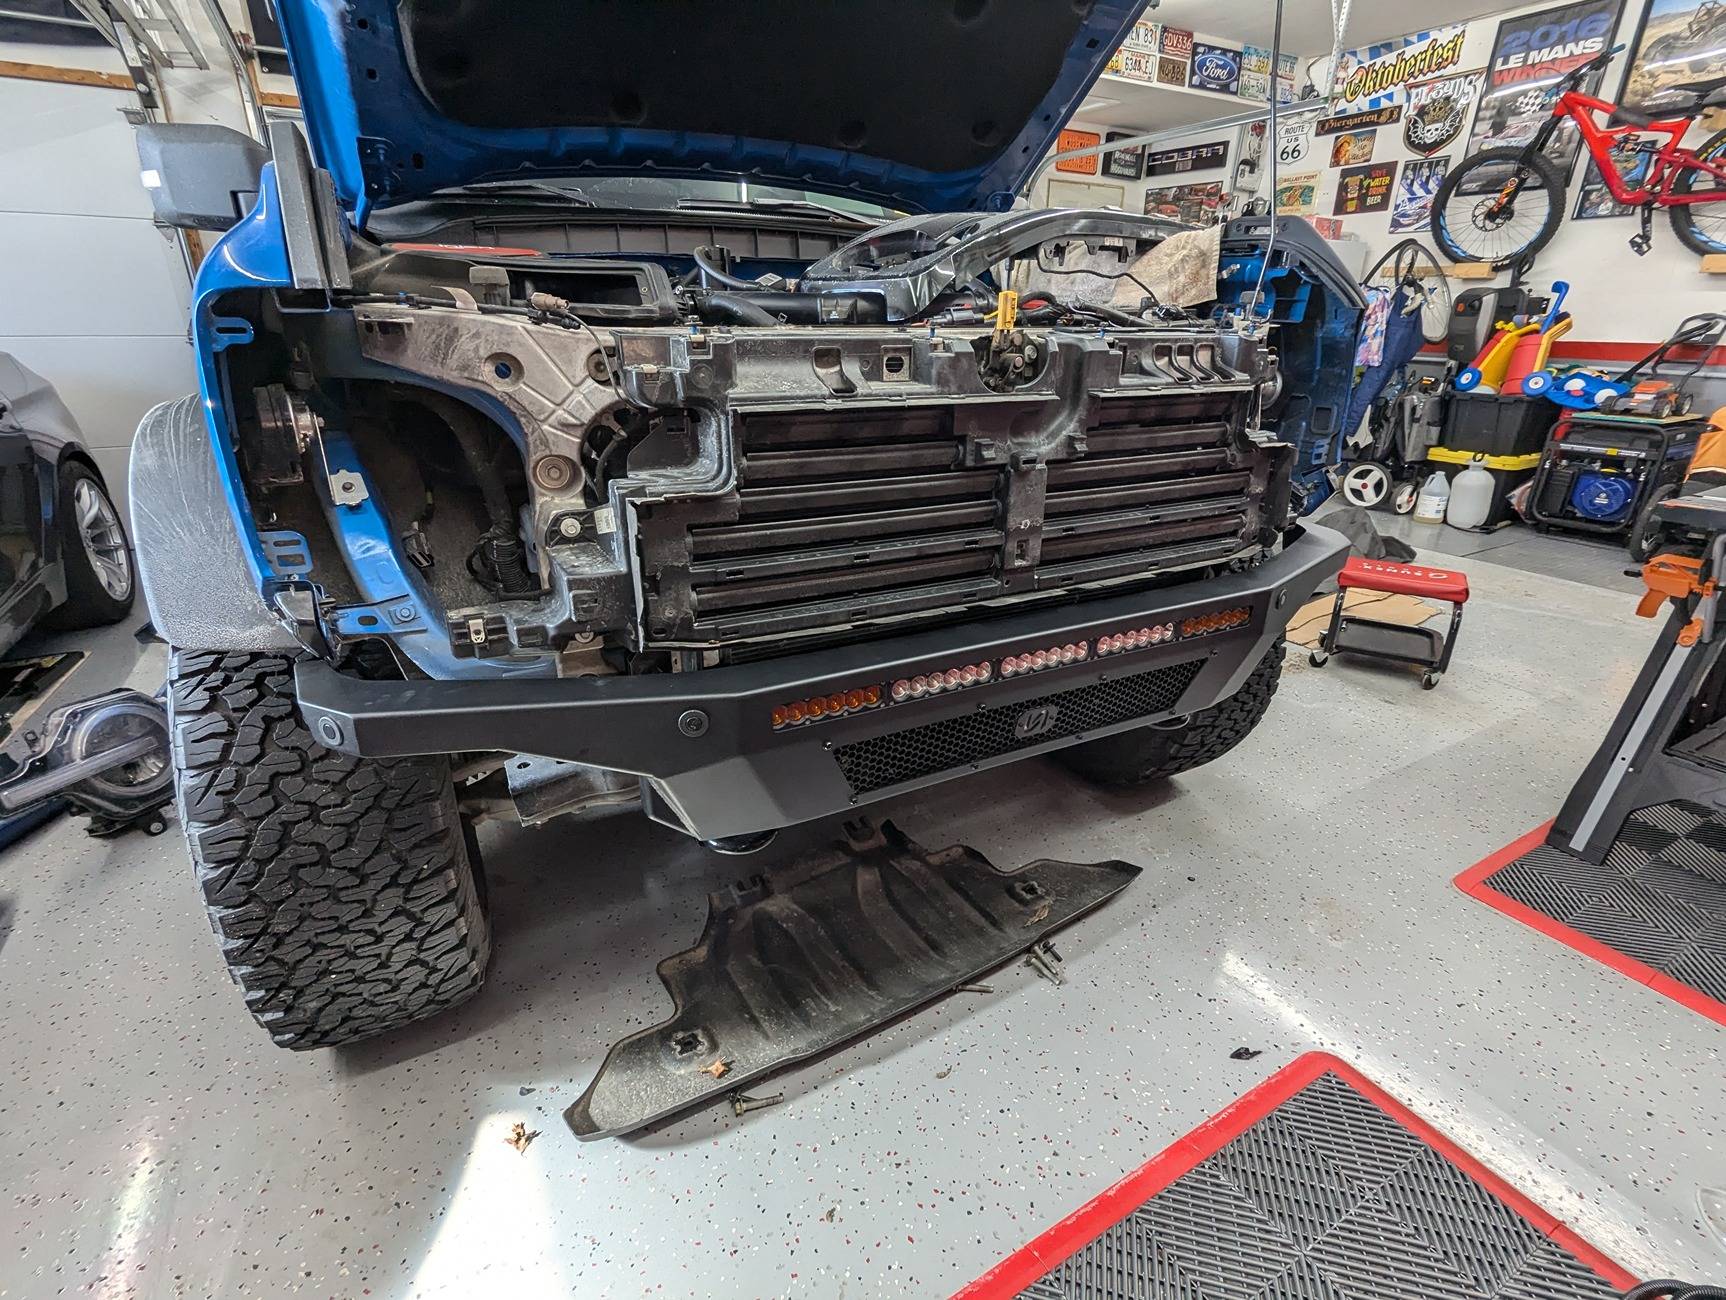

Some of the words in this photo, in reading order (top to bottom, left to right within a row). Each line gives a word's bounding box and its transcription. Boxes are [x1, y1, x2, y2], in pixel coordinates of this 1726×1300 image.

[1163, 32, 1193, 50] GDV336
[1501, 12, 1610, 55] 2016
[1494, 52, 1525, 71] LE
[1527, 37, 1604, 66] MANS
[1202, 57, 1230, 80] Ford
[1345, 29, 1466, 103] Oktoberfest
[1284, 125, 1305, 135] ROUTE
[1280, 144, 1301, 161] 66
[1370, 176, 1391, 187] WATER
[1366, 195, 1382, 206] BEER
